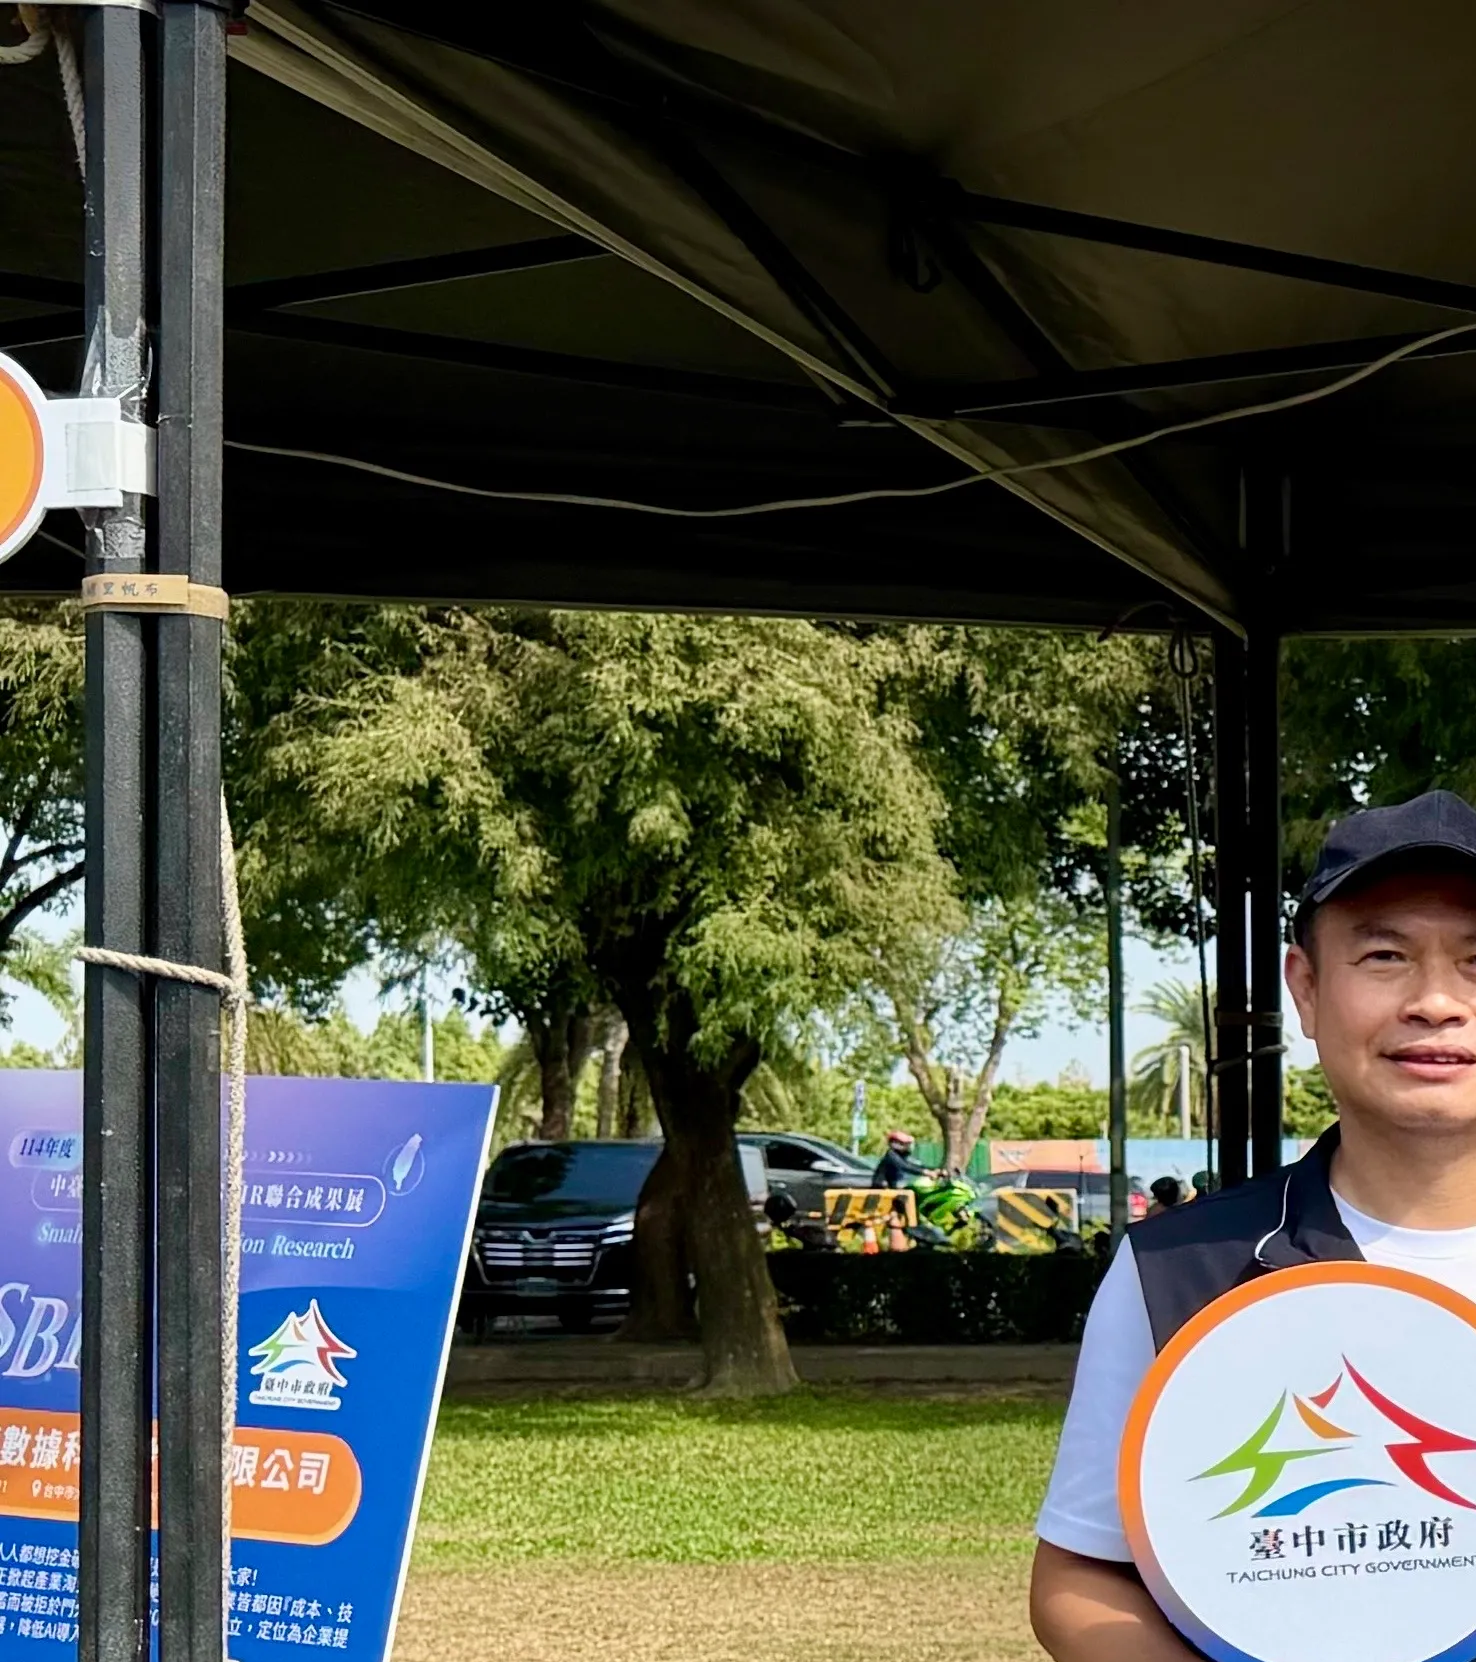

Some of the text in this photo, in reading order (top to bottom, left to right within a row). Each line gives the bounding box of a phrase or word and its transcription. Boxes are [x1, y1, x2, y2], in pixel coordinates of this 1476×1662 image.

[20, 1136, 75, 1159] 114年度
[37, 1221, 82, 1245] Smal
[270, 1233, 356, 1260] Research
[0, 1281, 82, 1379] SB
[1247, 1516, 1455, 1561] 臺中市政府
[1226, 1564, 1316, 1584] TAICHUNG
[1320, 1561, 1361, 1578] CITY
